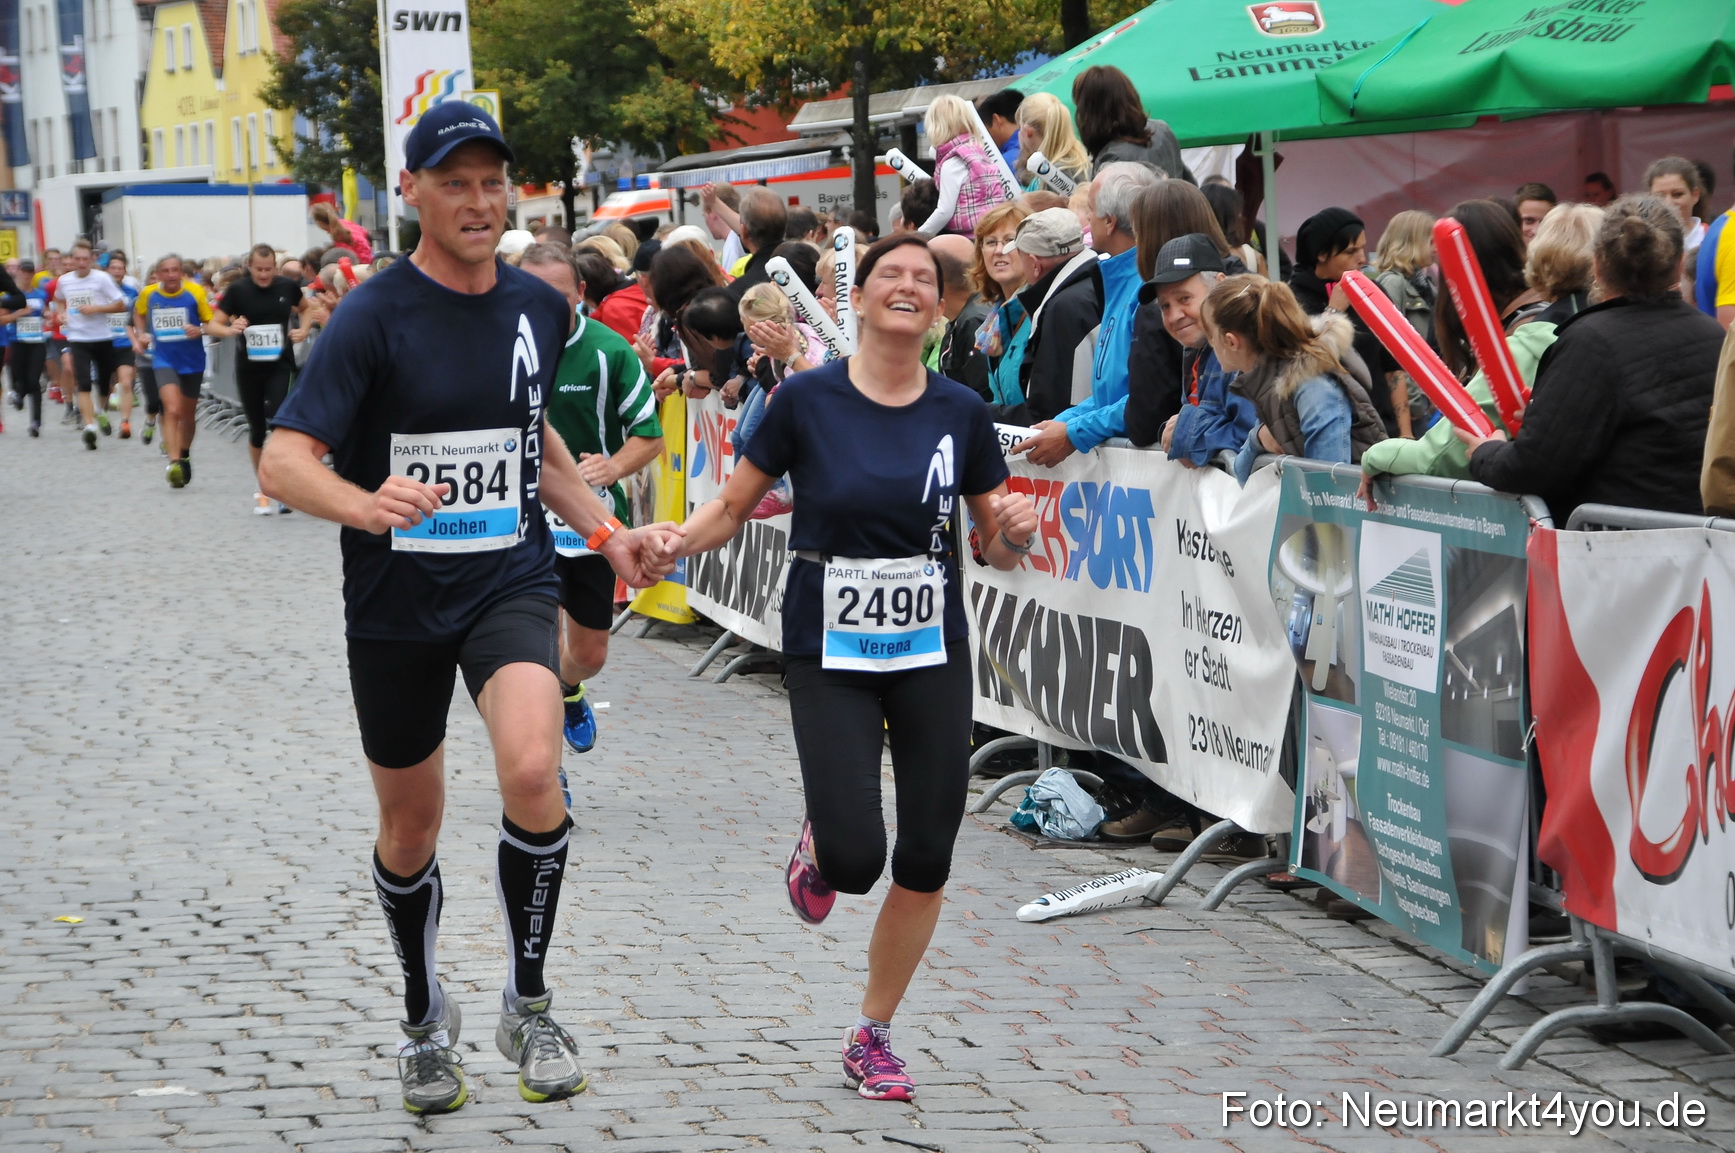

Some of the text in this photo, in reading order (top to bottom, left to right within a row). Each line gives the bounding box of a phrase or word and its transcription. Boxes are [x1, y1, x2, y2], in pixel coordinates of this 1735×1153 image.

[392, 9, 462, 32] swn
[1279, 26, 1309, 34] 1628
[1216, 40, 1382, 63] Neumarkte
[835, 262, 848, 303] BMW
[155, 316, 183, 328] 2606
[249, 333, 279, 347] 3314
[559, 384, 587, 393] africon
[393, 442, 499, 456] PARTL Neumarkt
[406, 459, 509, 506] 2584
[428, 518, 487, 535] Jochen
[1483, 517, 1506, 539] Bayern
[828, 567, 921, 580] PARTL Neumarkt
[838, 583, 934, 627] 2490
[1181, 590, 1242, 644] In Herzen
[1366, 600, 1436, 637] MATHI HOFFER
[859, 638, 911, 654] Verena
[1401, 639, 1435, 658] TROCKENBAU
[1202, 645, 1232, 692] Stadt
[1382, 651, 1414, 671] FASSADENBAU
[1387, 792, 1421, 822] Trockenbau
[1367, 811, 1442, 857] Fassadenverkleidungen
[1406, 873, 1452, 907] Sanierungen
[523, 857, 560, 959] Kalenji
